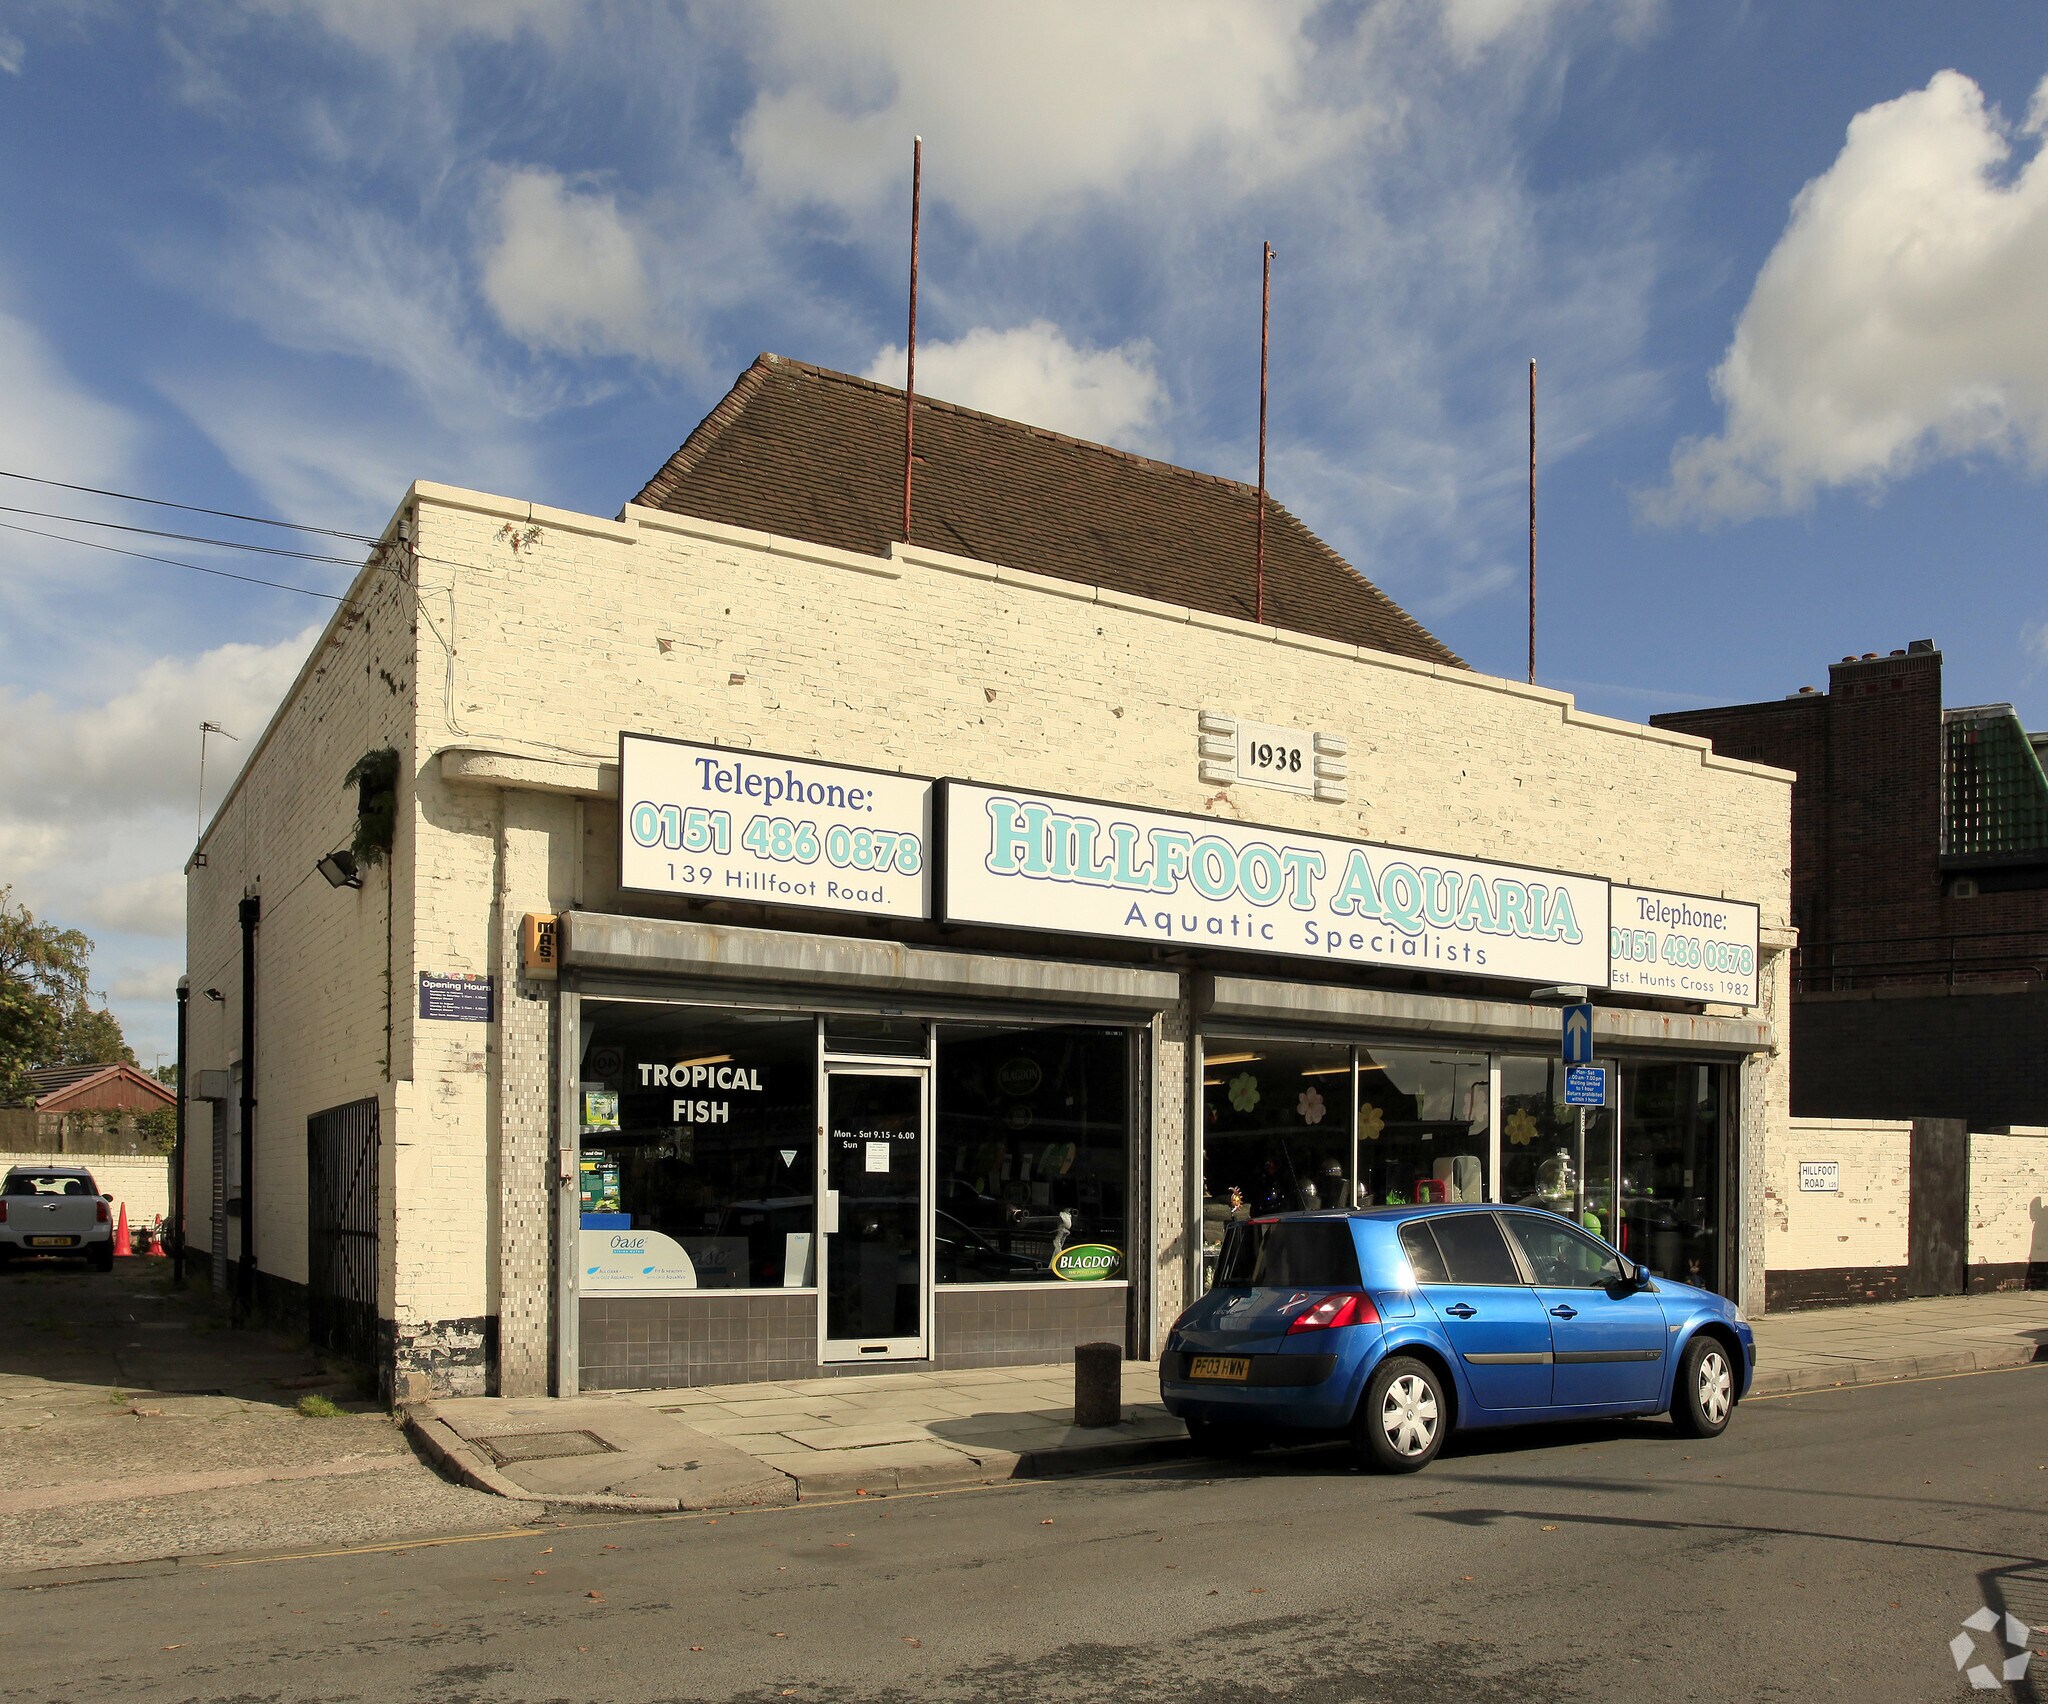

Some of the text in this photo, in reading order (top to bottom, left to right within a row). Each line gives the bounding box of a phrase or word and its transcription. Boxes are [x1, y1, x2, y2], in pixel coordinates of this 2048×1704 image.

[1251, 741, 1301, 773] 1938
[695, 757, 873, 812] Telephone:
[630, 801, 923, 876] 0151 486 0878
[667, 863, 891, 904] 139 Hillfoot Road.
[985, 796, 1583, 945] HILLFOOT AQUARIA
[1636, 897, 1727, 931] Telephone:
[1123, 901, 1487, 965] Aquatic Specialists
[1611, 926, 1754, 976] 0151 486 0878
[422, 980, 491, 992] Opening Hours
[1612, 969, 1749, 997] Est. Hunts Cross 1982
[638, 1063, 763, 1091] TROPICAL
[673, 1100, 729, 1124] FISH
[833, 1130, 851, 1138] Mon
[859, 1130, 872, 1138] Sat
[873, 1131, 890, 1139] 9.15
[898, 1131, 915, 1139] 6.00
[843, 1140, 858, 1149] Sun
[1802, 1165, 1836, 1175] HILLFOOT
[1805, 1178, 1825, 1188] ROAD
[610, 1235, 645, 1248] Oase
[1060, 1255, 1119, 1268] BLAGDON
[1194, 1359, 1220, 1375] PF03
